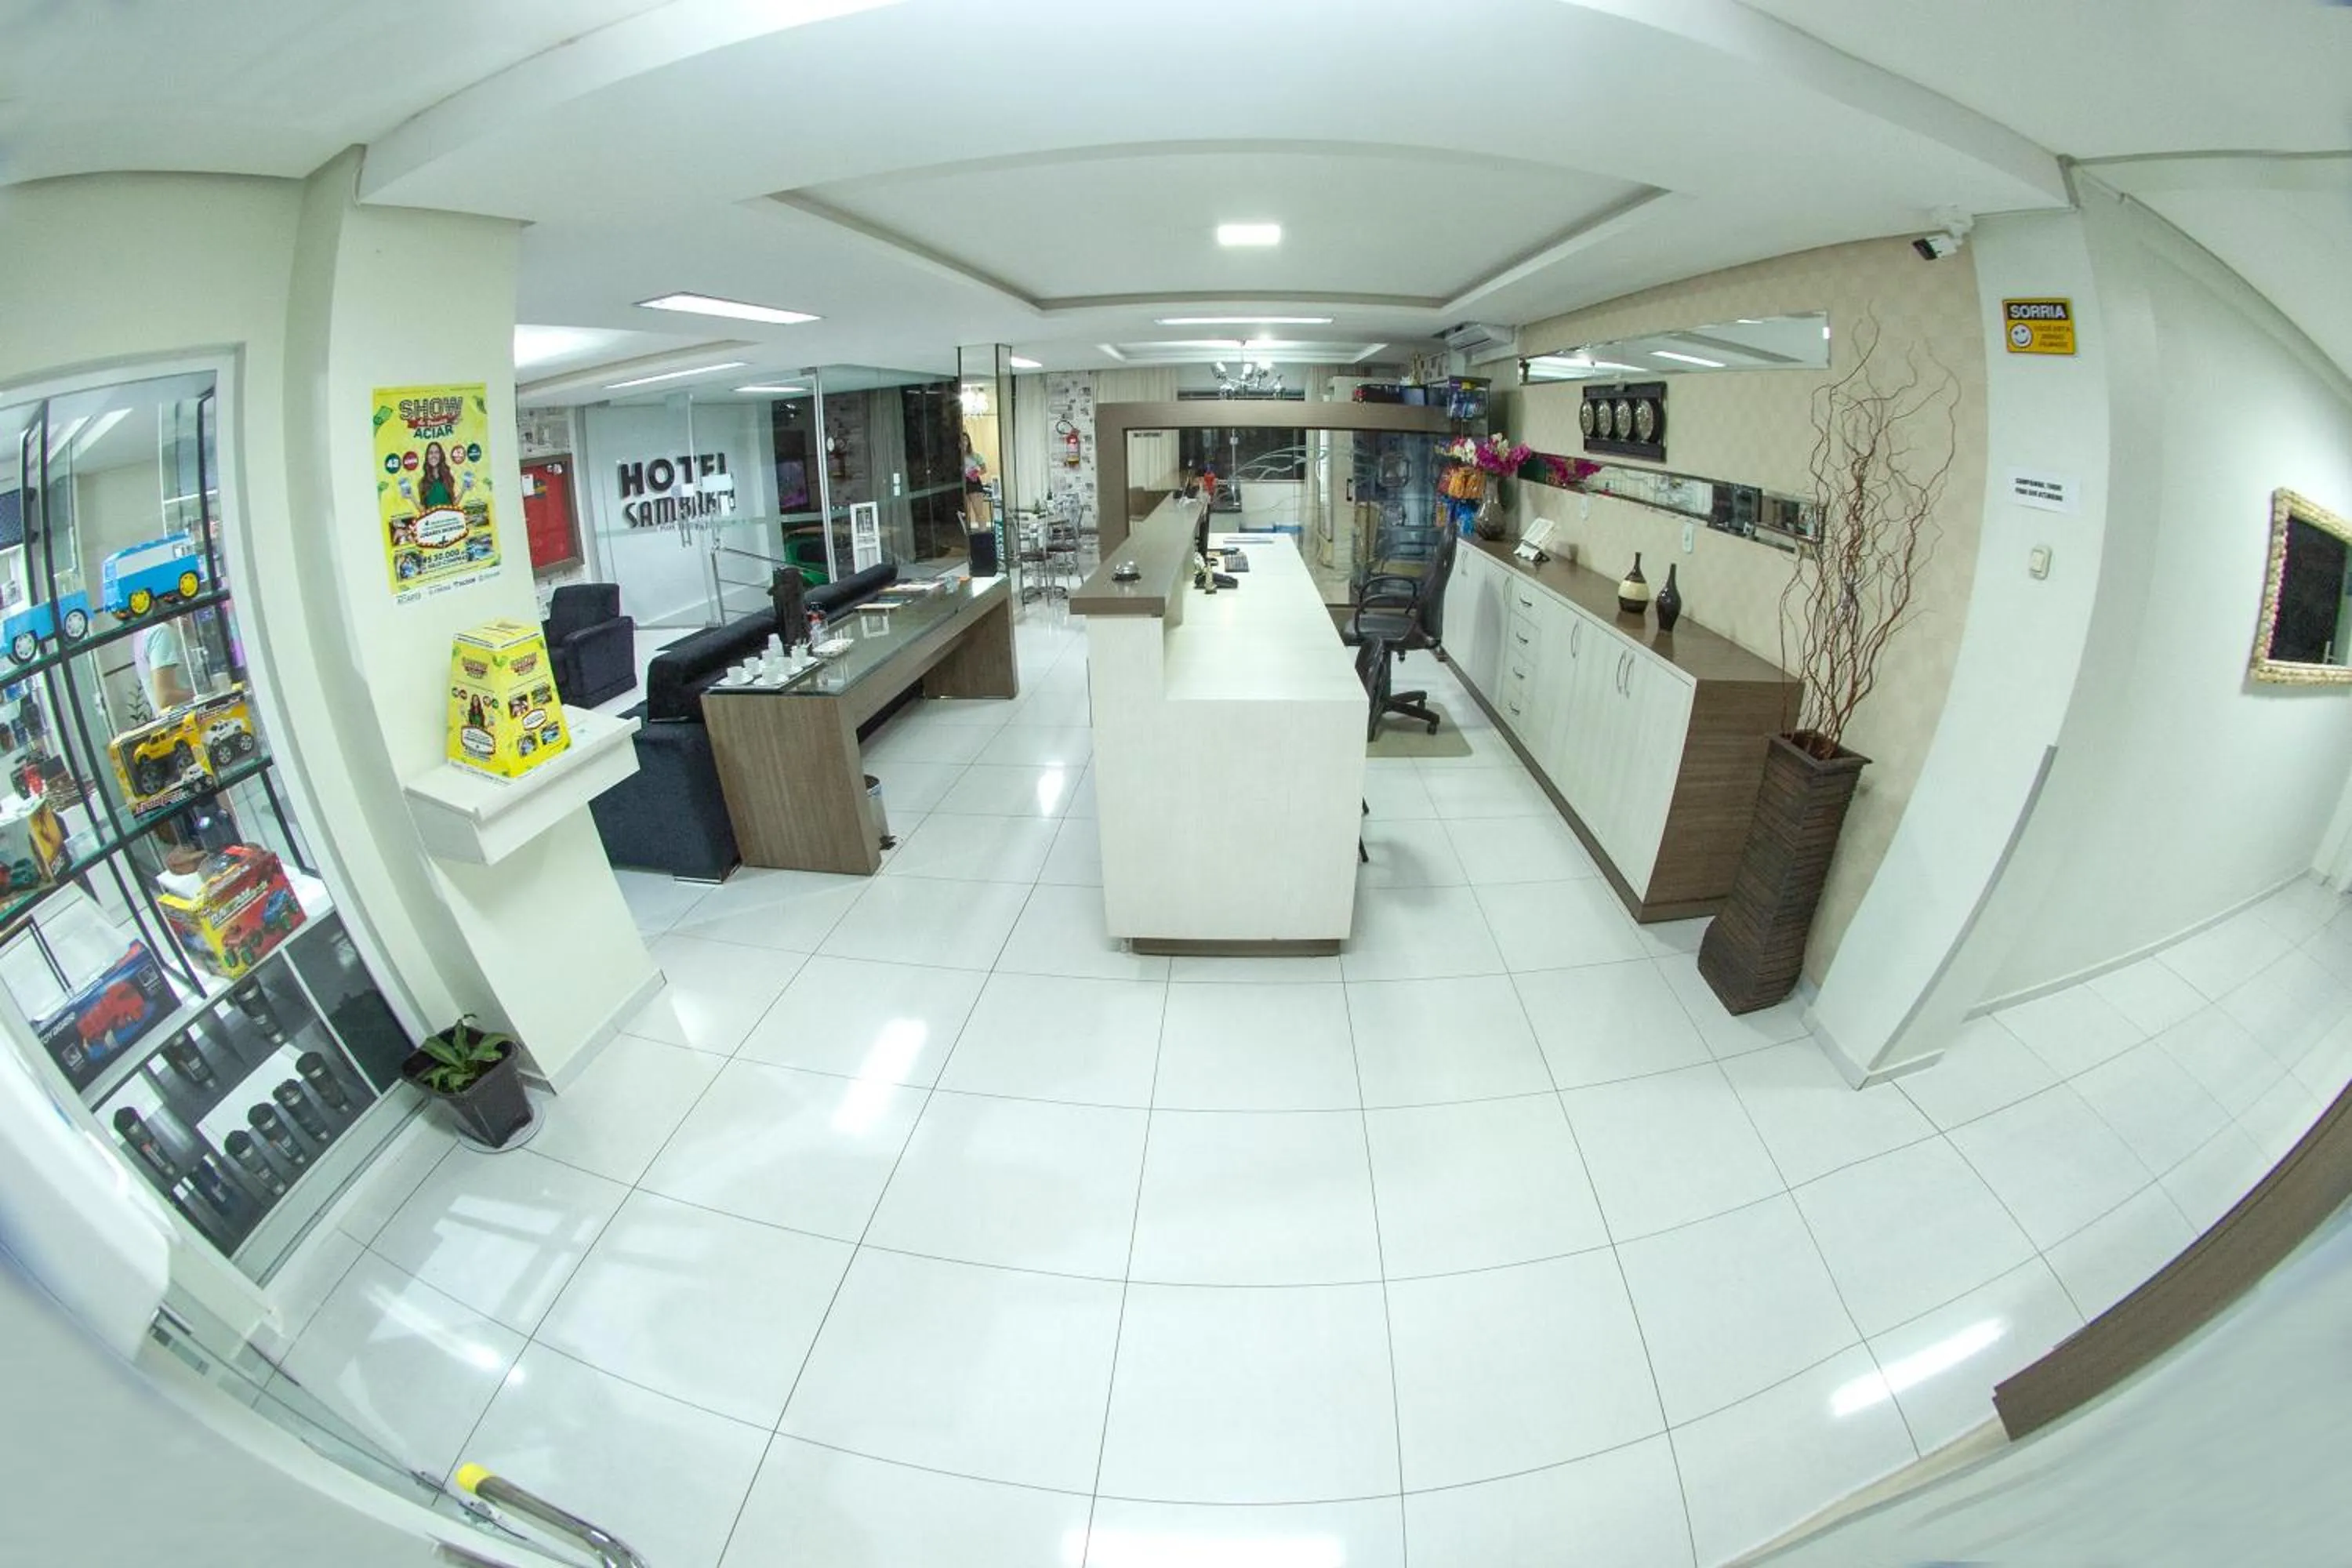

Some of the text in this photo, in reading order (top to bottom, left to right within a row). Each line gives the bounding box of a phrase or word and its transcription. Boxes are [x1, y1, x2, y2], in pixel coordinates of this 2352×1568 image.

[2009, 304, 2067, 319] SORRIA
[398, 396, 463, 421] SHOW
[413, 424, 453, 439] ACIAR
